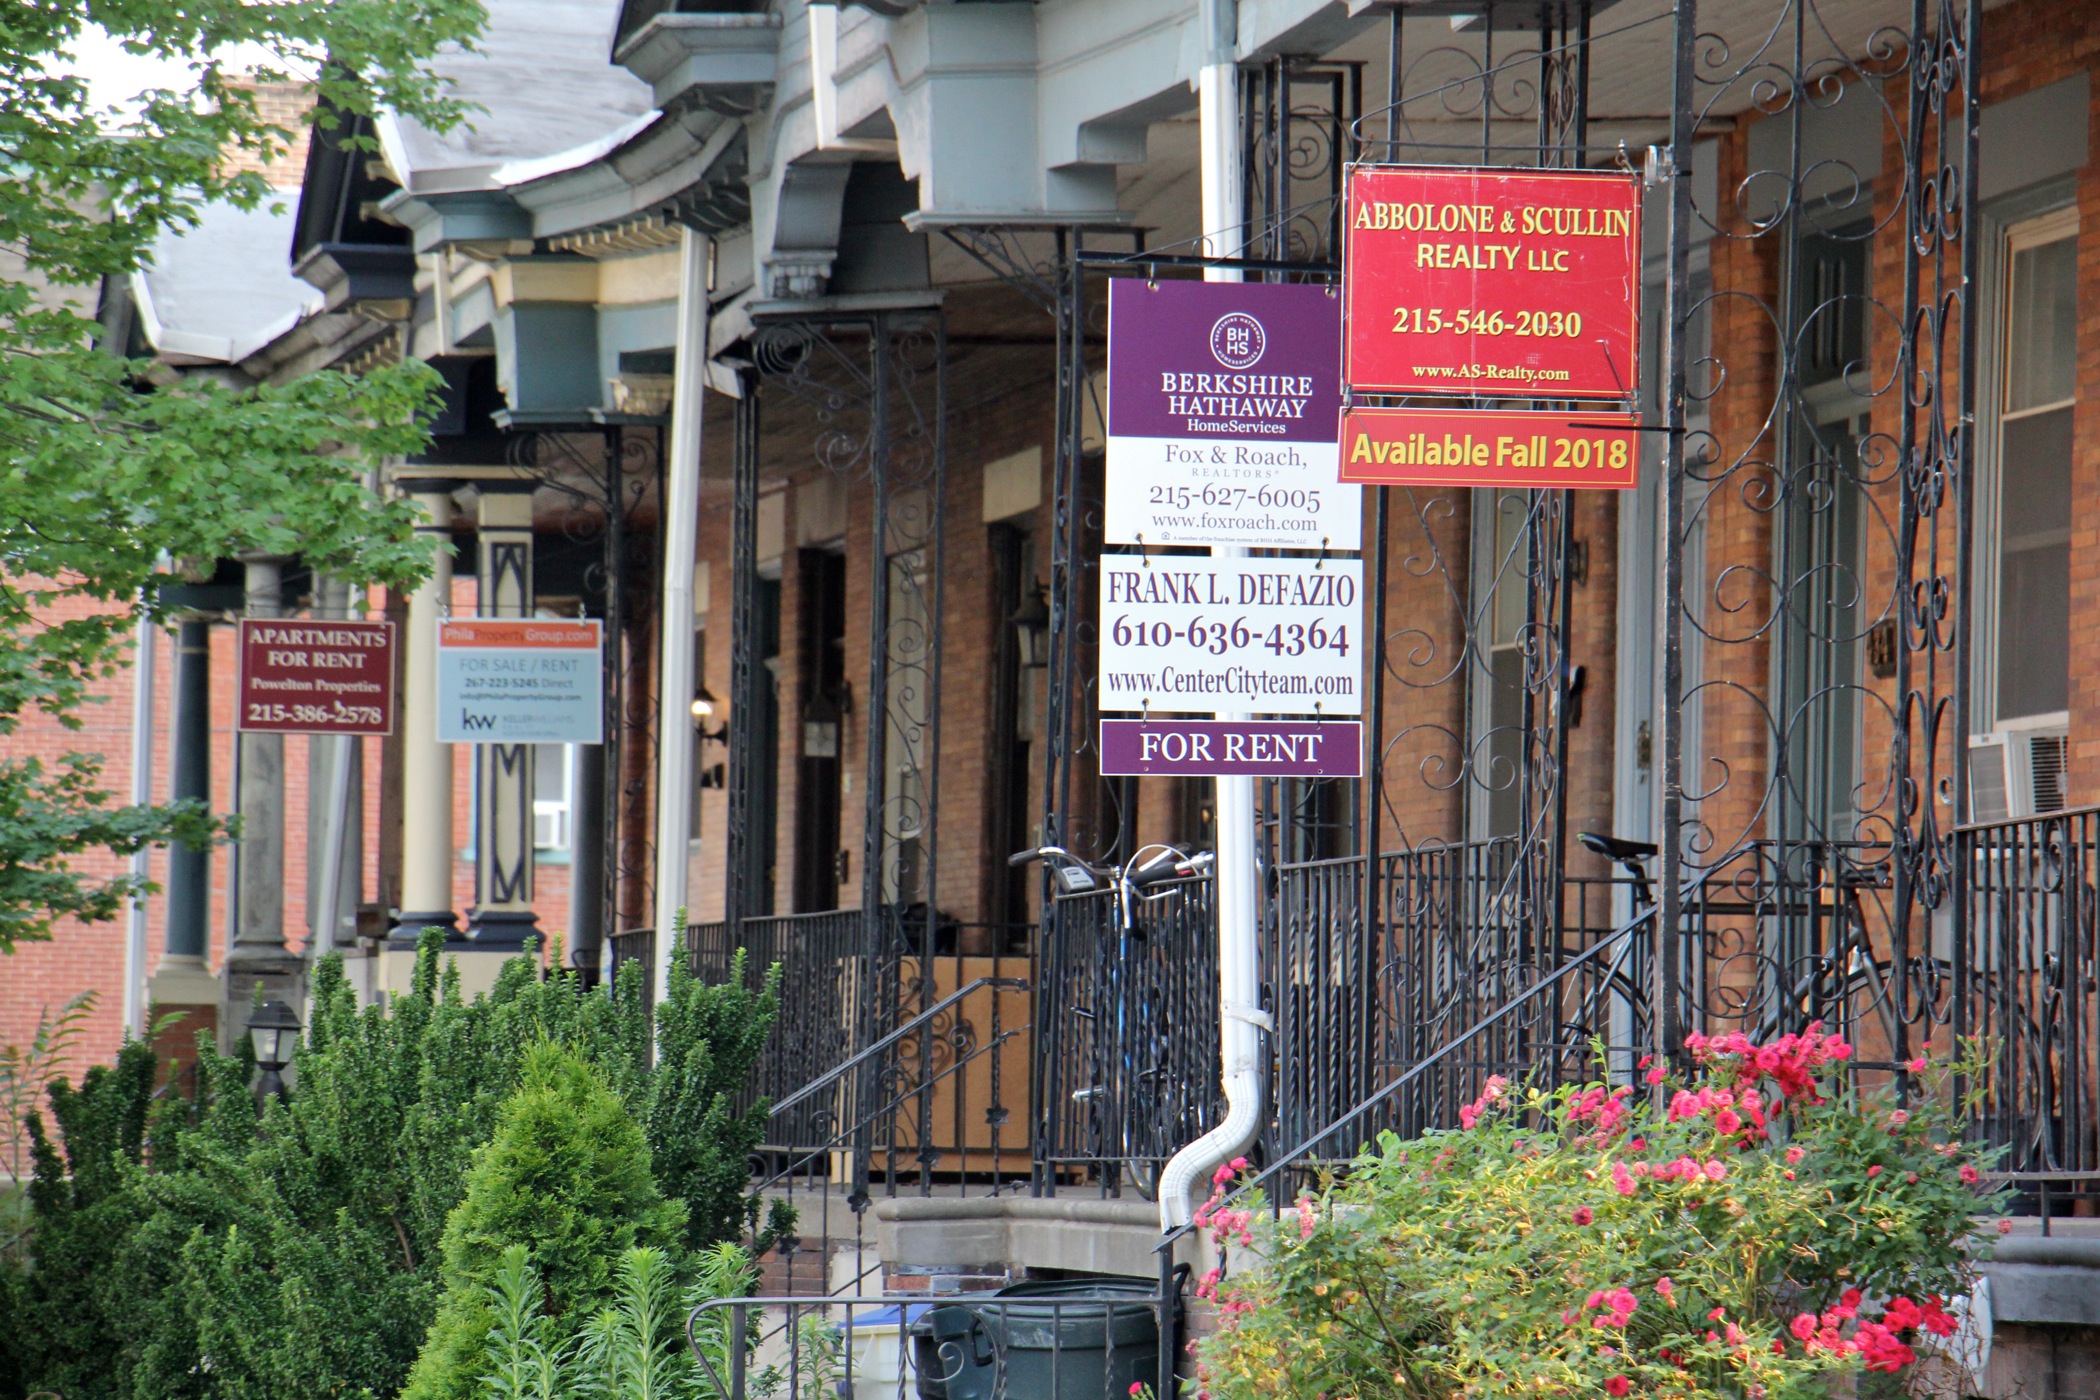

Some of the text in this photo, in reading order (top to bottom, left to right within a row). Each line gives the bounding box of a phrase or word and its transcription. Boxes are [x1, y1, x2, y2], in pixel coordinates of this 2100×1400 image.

[1354, 202, 1632, 237] ABBOLONE & SCULLIN
[1417, 243, 1569, 272] REALTY LLC
[1392, 307, 1581, 338] 215-546-2030
[1227, 327, 1249, 341] BH
[1227, 341, 1249, 355] HS
[1412, 364, 1570, 381] www.AS-Realty.com
[1161, 372, 1313, 396] BERKSHIRE
[1168, 396, 1307, 418] HATHAWAY
[1187, 418, 1286, 434] HomeServices
[1164, 444, 1308, 470] Fox & Roach,
[1350, 433, 1628, 469] Available Fall 2018
[1149, 482, 1320, 514] 215-627-6005
[1152, 511, 1317, 531] www.foxroach.com
[1108, 571, 1355, 607] FRANK L. DEFAZIO
[249, 628, 387, 648] APARTMENTS
[1112, 614, 1349, 657] 610-636-4364
[267, 650, 367, 669] FOR RENT
[460, 657, 579, 673] FOR SALE / RENT
[251, 677, 381, 695] Powelton Properties
[541, 678, 574, 689] Direct
[1108, 665, 1353, 701] www.CenterCityteam.com
[248, 702, 383, 724] 215-386-2578
[462, 707, 497, 730] kw
[1139, 732, 1323, 763] FOR RENT
